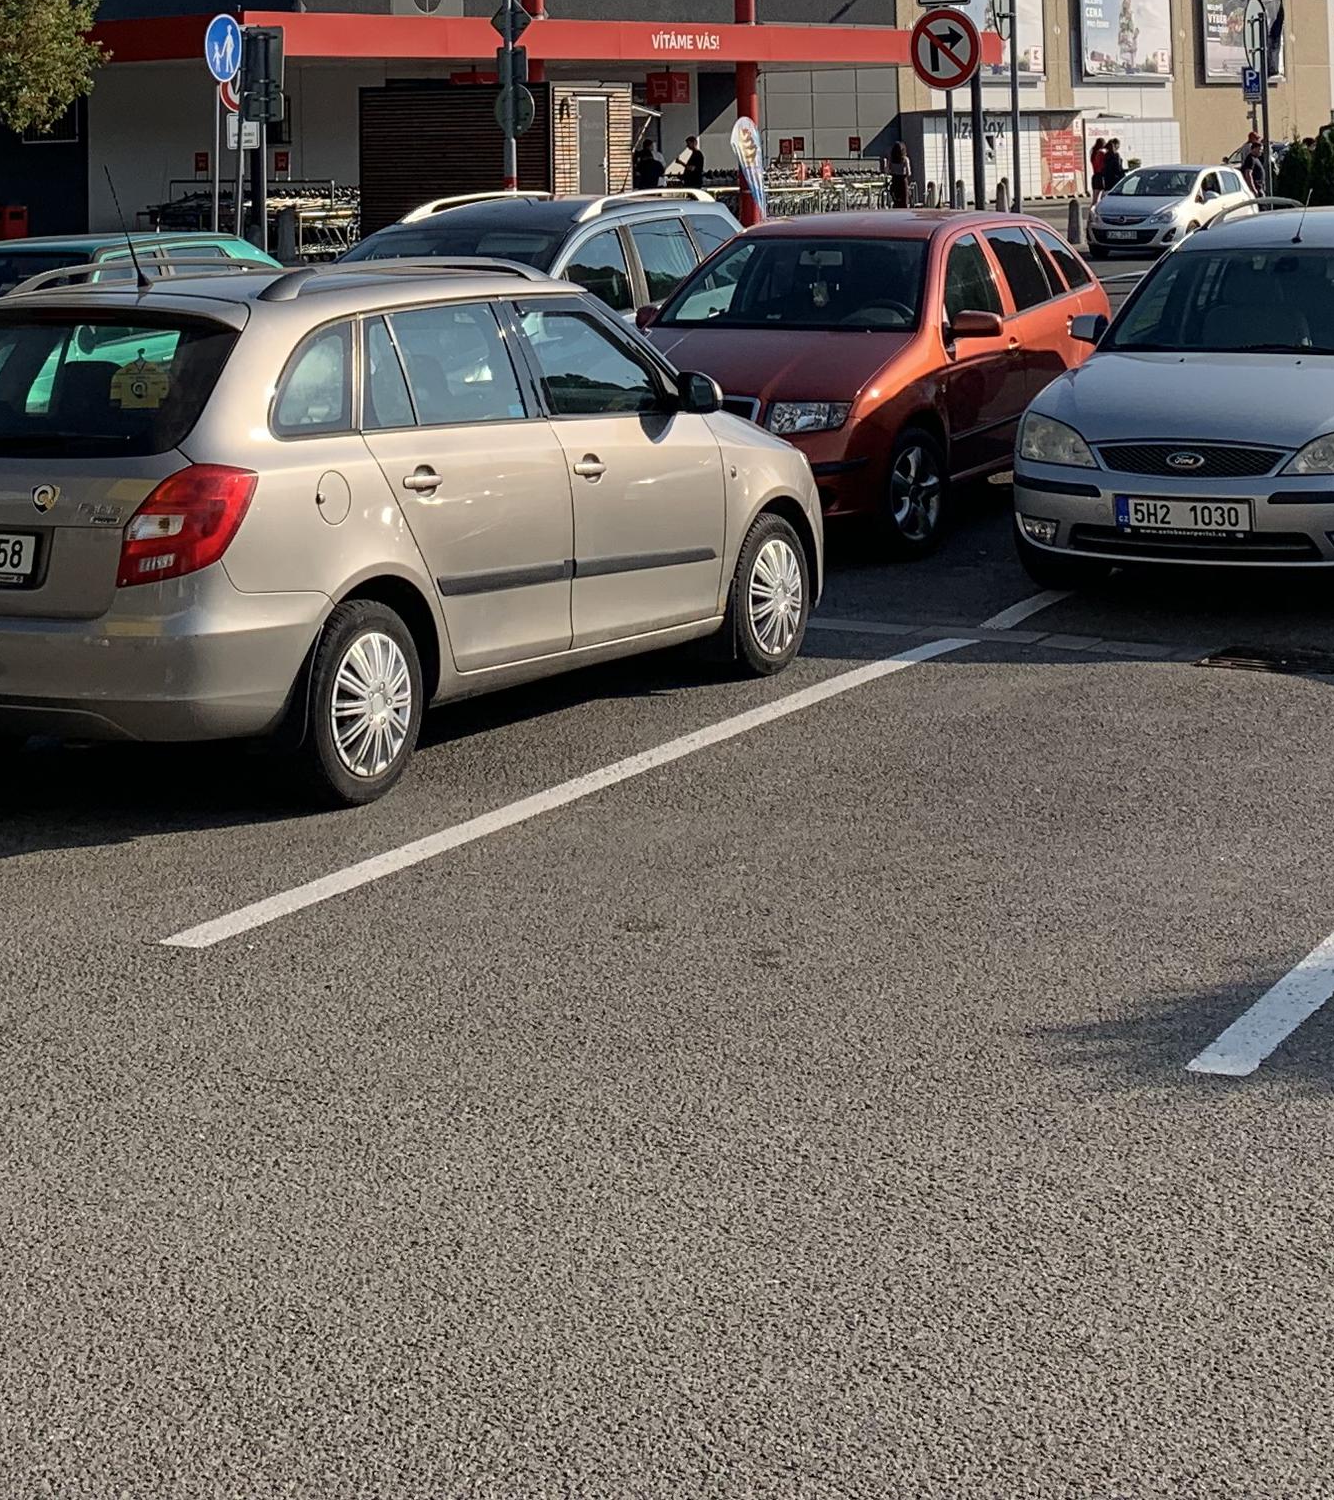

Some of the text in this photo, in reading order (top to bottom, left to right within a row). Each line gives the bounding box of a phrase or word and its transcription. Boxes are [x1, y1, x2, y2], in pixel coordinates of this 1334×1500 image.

[651, 31, 720, 50] VÍTÁME VÁS!
[1246, 70, 1257, 86] P
[1133, 502, 1239, 527] 5H2 1030
